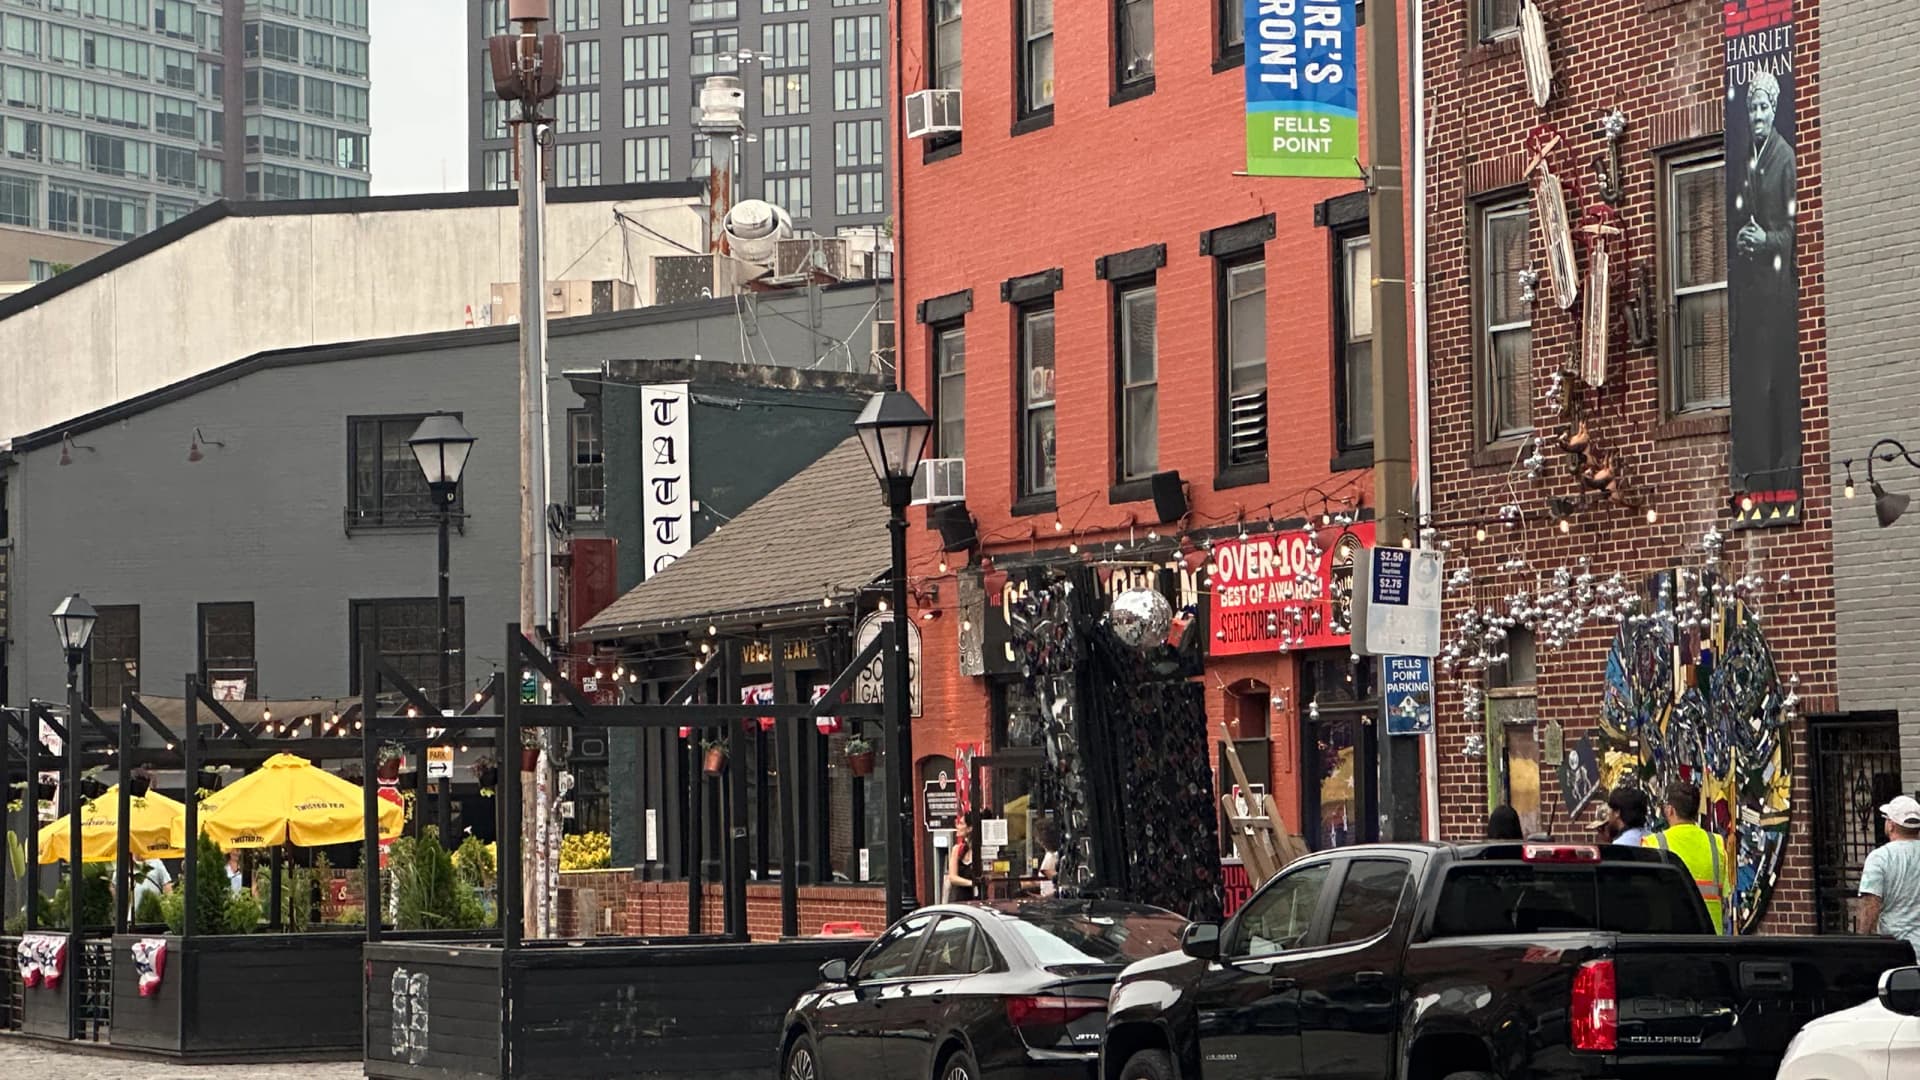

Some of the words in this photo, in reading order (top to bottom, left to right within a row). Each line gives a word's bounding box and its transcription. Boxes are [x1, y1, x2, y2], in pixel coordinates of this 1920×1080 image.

[1303, 0, 1343, 84] RE'S
[1726, 24, 1792, 62] HARRIET
[1726, 51, 1792, 87] TUBMAN
[1273, 117, 1331, 133] FELLS
[1273, 137, 1333, 153] POINT
[1218, 541, 1274, 582] OVER
[1278, 538, 1322, 577] 100
[1380, 551, 1404, 562] $2.50
[1379, 578, 1402, 589] $2.75
[1221, 584, 1248, 607] BEST
[1249, 583, 1265, 604] OF
[861, 657, 916, 682] SOD
[1391, 659, 1422, 670] FELLS
[1392, 671, 1422, 681] POINT
[1387, 682, 1429, 693] PARKING
[294, 802, 328, 811] TWISTED
[1630, 1035, 1701, 1044] COLORADO
